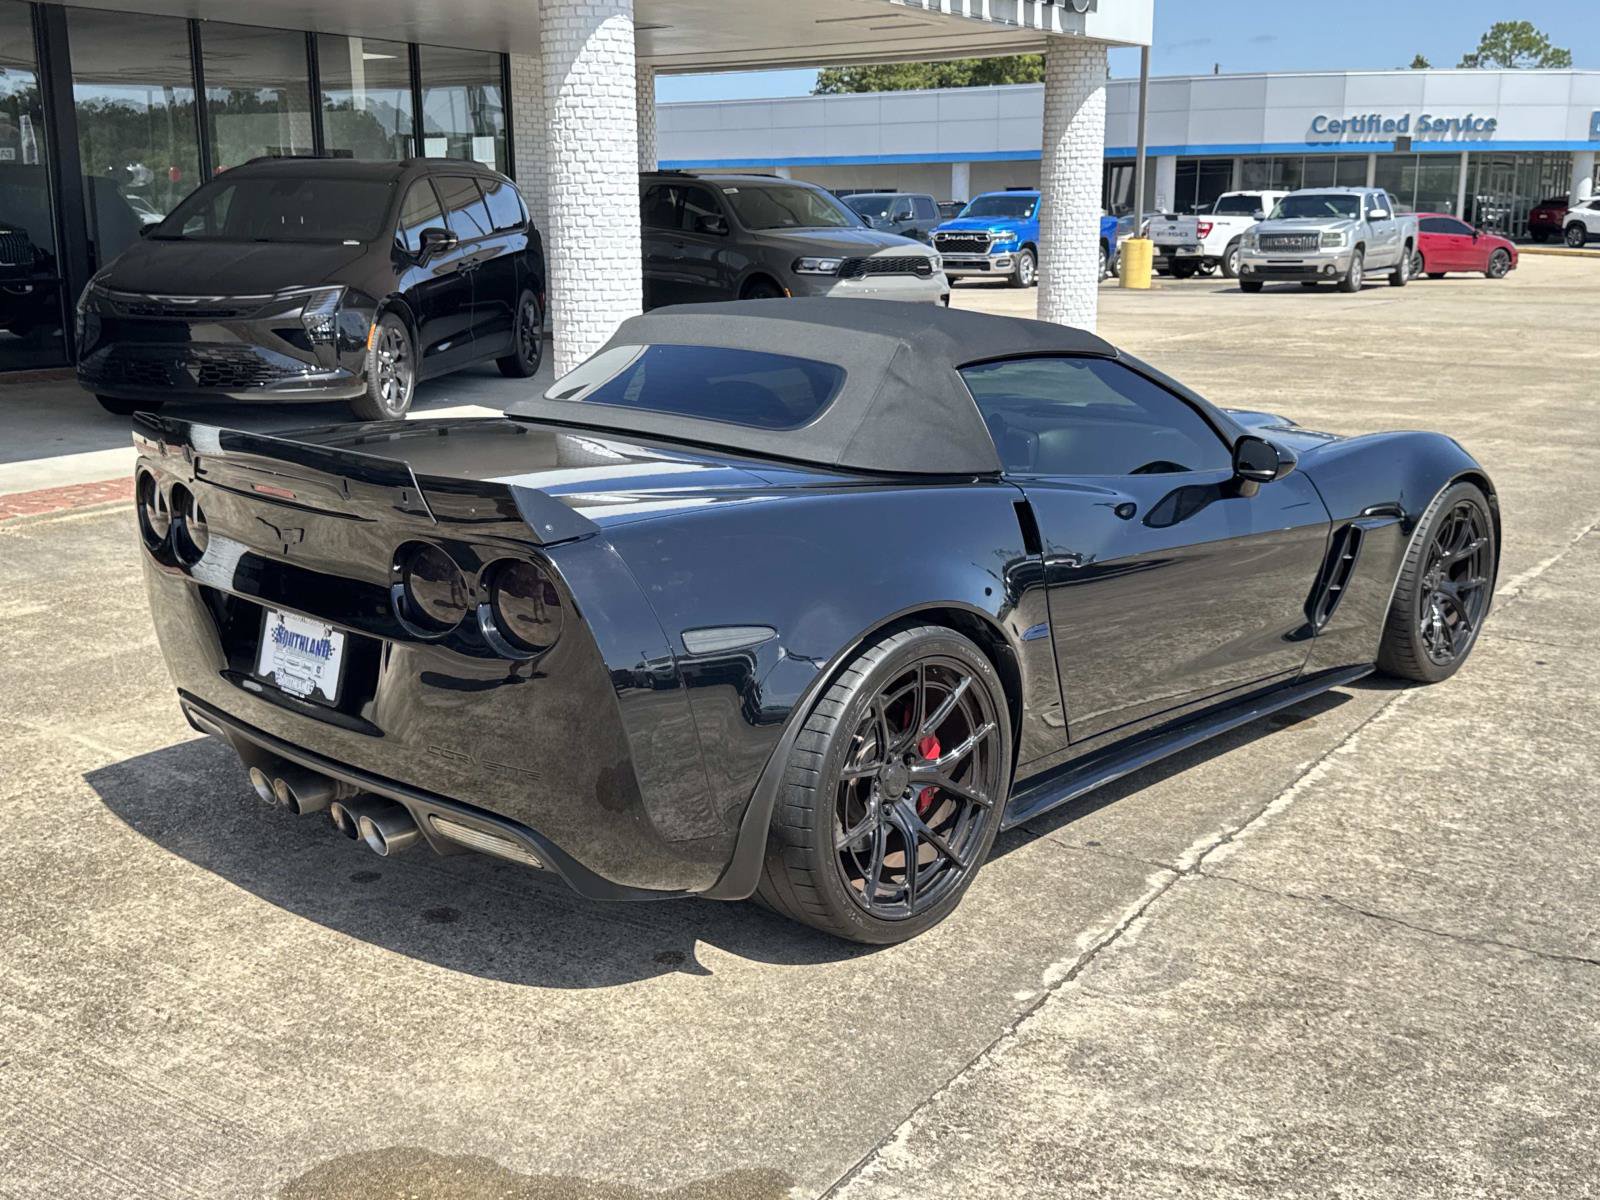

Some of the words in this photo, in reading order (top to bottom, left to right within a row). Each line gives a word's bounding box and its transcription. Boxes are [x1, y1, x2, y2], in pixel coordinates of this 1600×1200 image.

[1312, 113, 1410, 134] Certified
[1419, 113, 1497, 133] Service
[277, 624, 330, 659] SOUTHLAND
